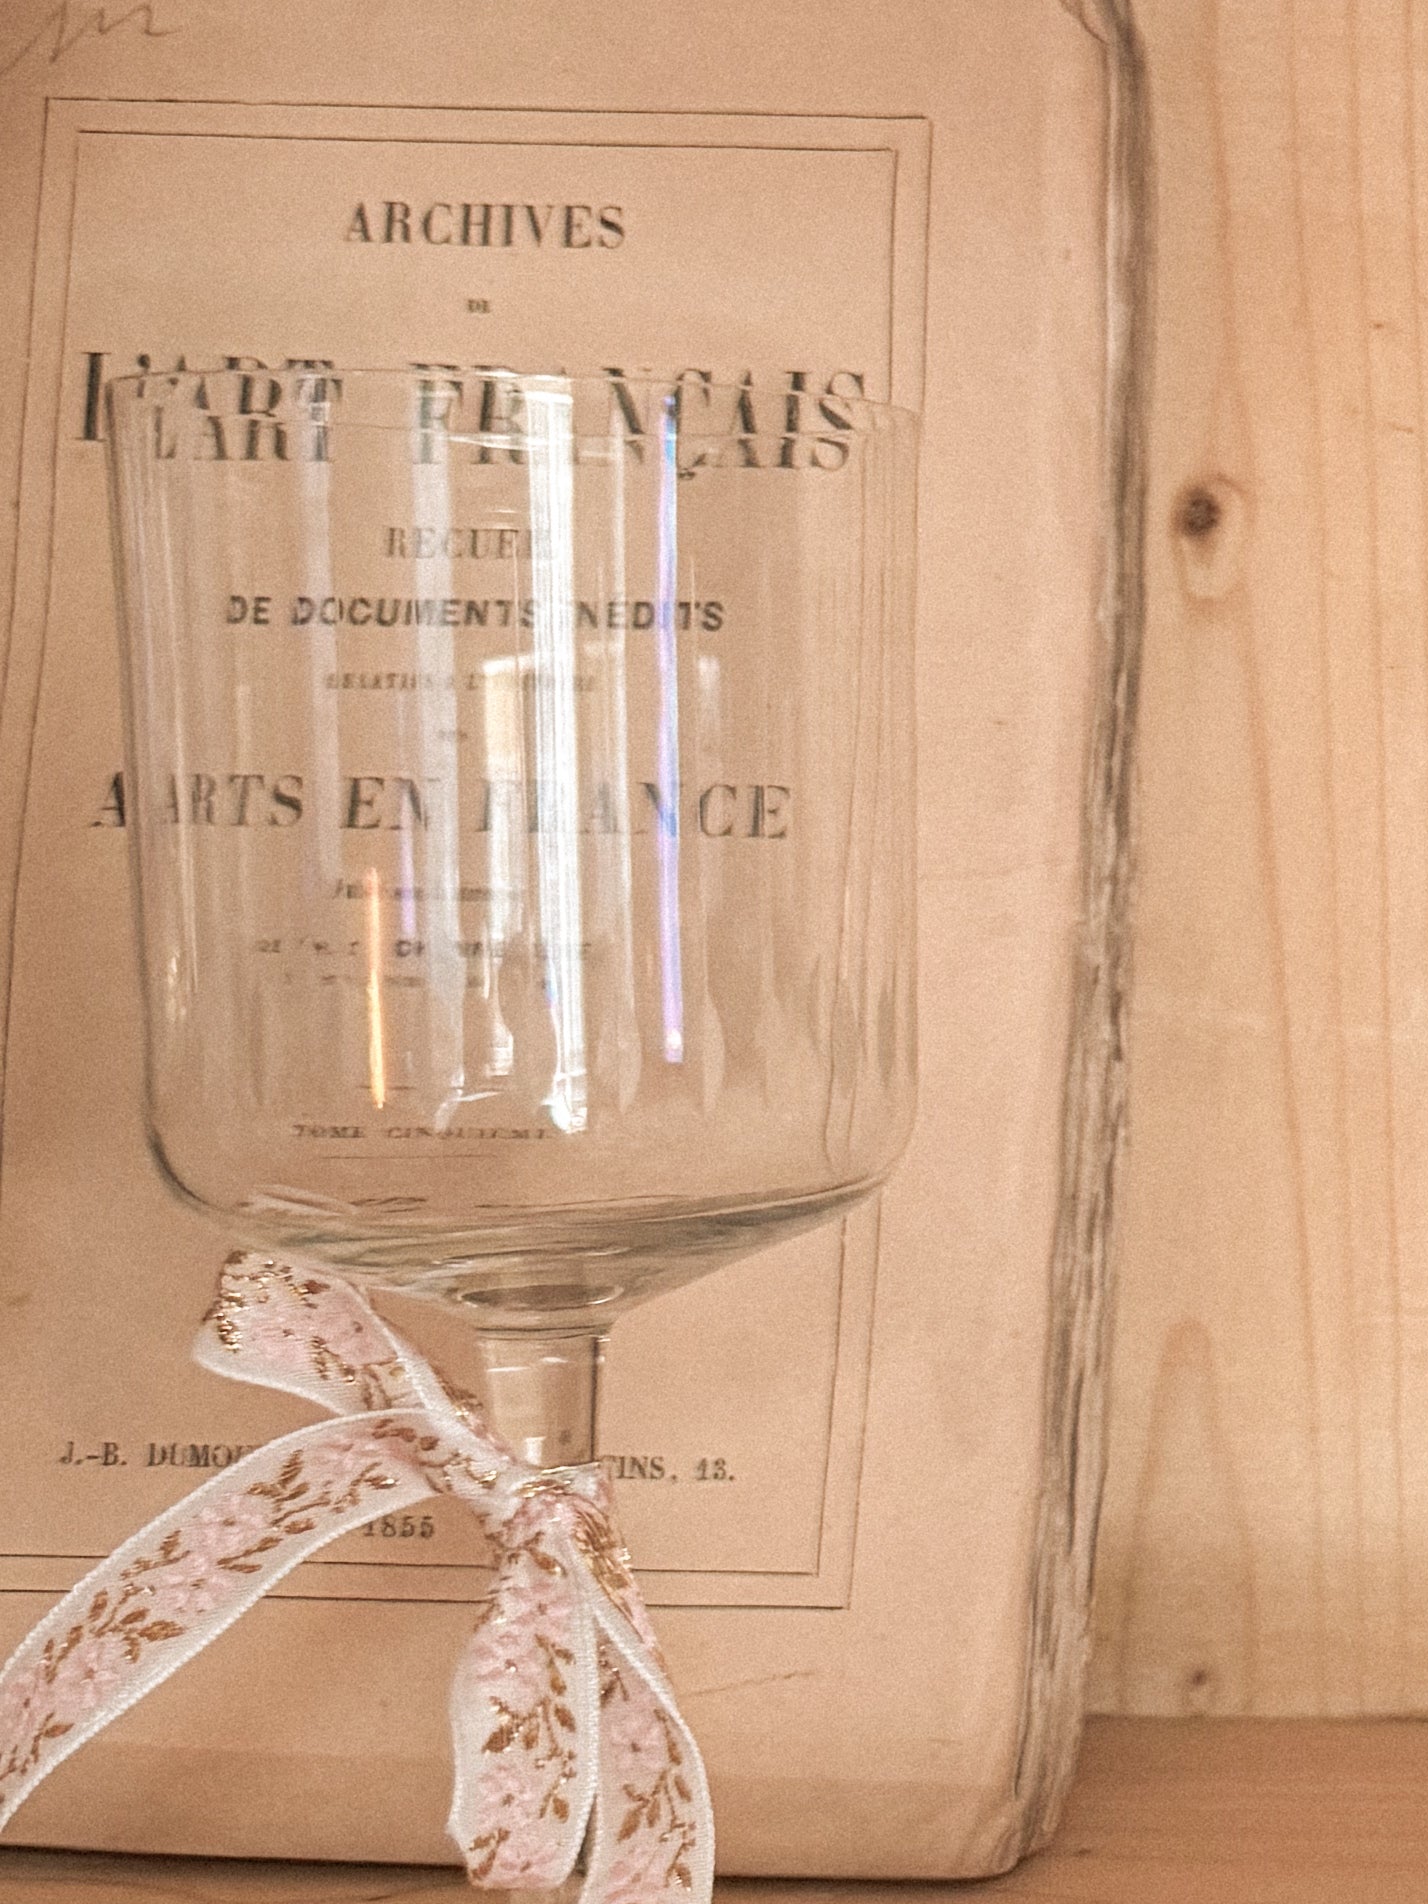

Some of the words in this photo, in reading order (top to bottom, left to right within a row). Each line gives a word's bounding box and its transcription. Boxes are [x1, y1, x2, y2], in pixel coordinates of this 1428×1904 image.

[344, 201, 627, 250] ARCHIVES
[467, 298, 491, 315] DE
[226, 594, 271, 626] DE
[291, 596, 542, 630] DOCUMENTS
[59, 1441, 128, 1467] J.-B.
[363, 1515, 435, 1539] 1855
